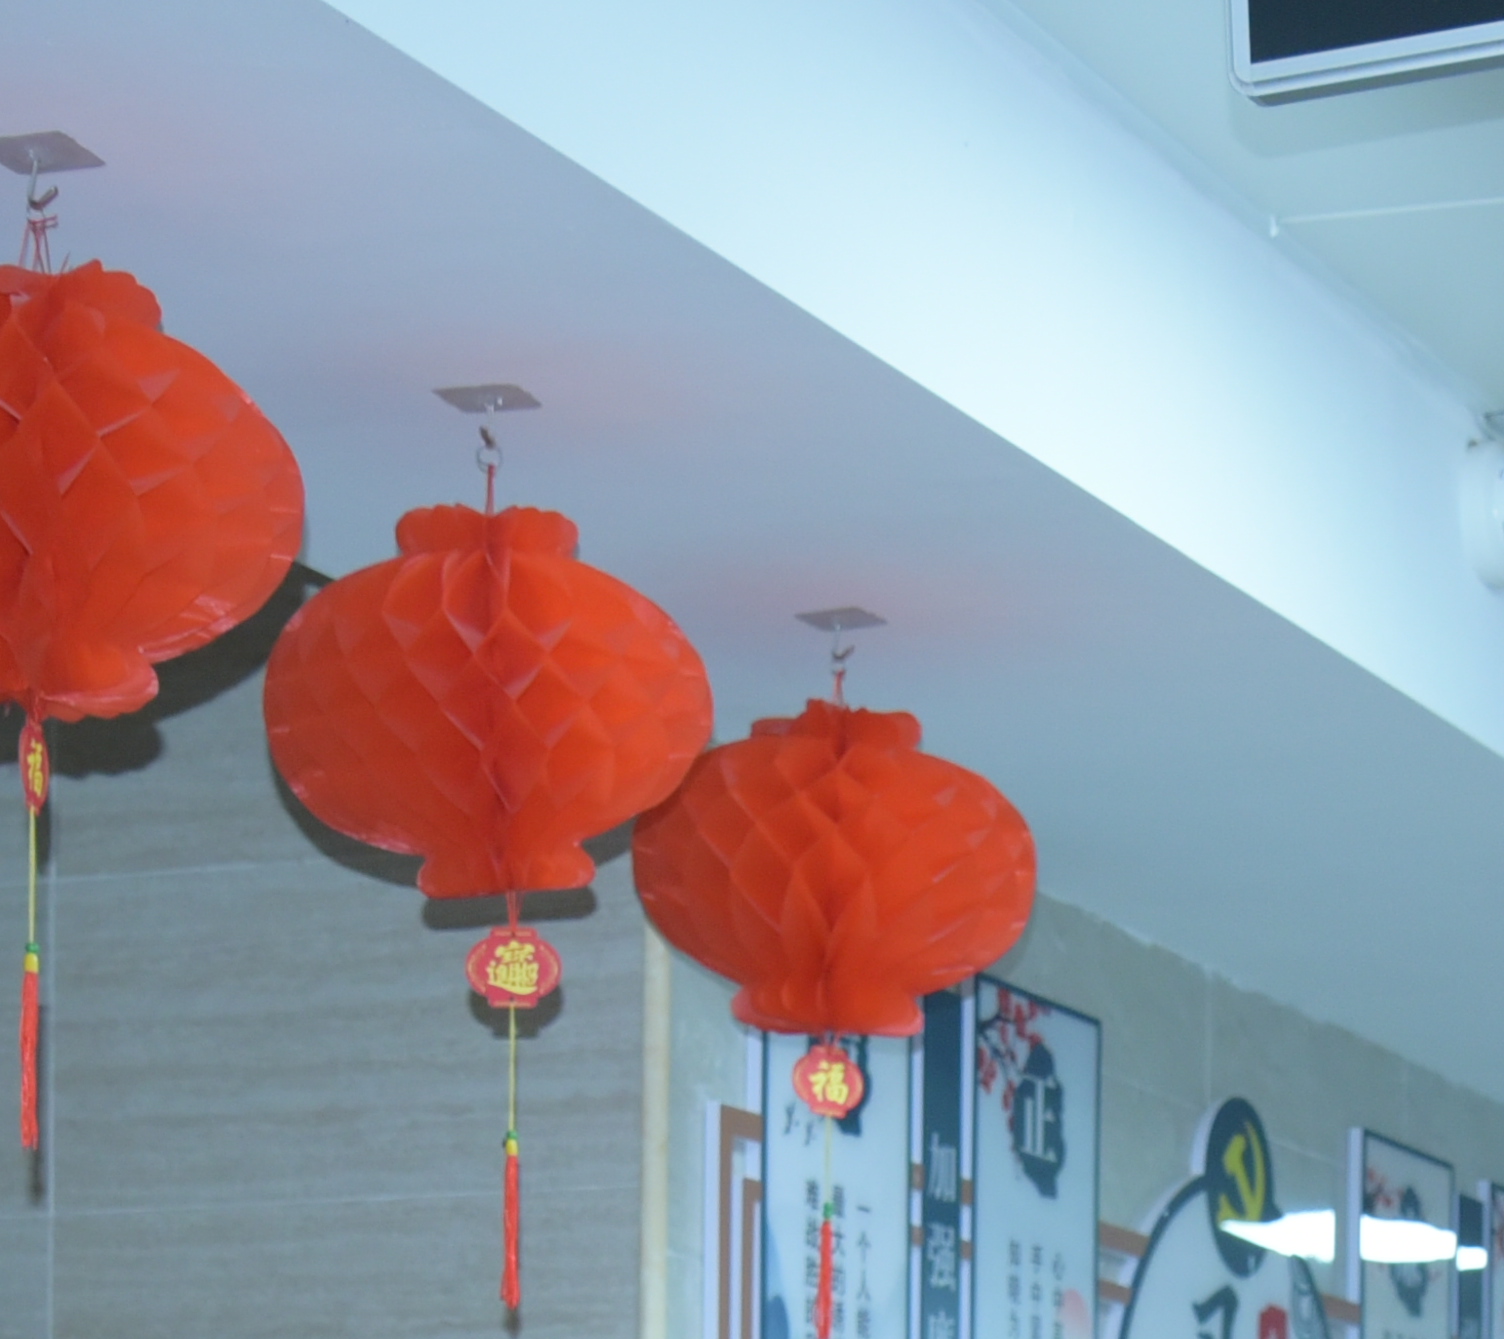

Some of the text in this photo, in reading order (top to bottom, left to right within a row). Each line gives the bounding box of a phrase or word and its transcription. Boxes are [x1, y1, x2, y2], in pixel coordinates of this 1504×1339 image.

[27, 738, 43, 797] 福
[809, 1060, 849, 1105] 福
[1021, 1072, 1058, 1163] 正
